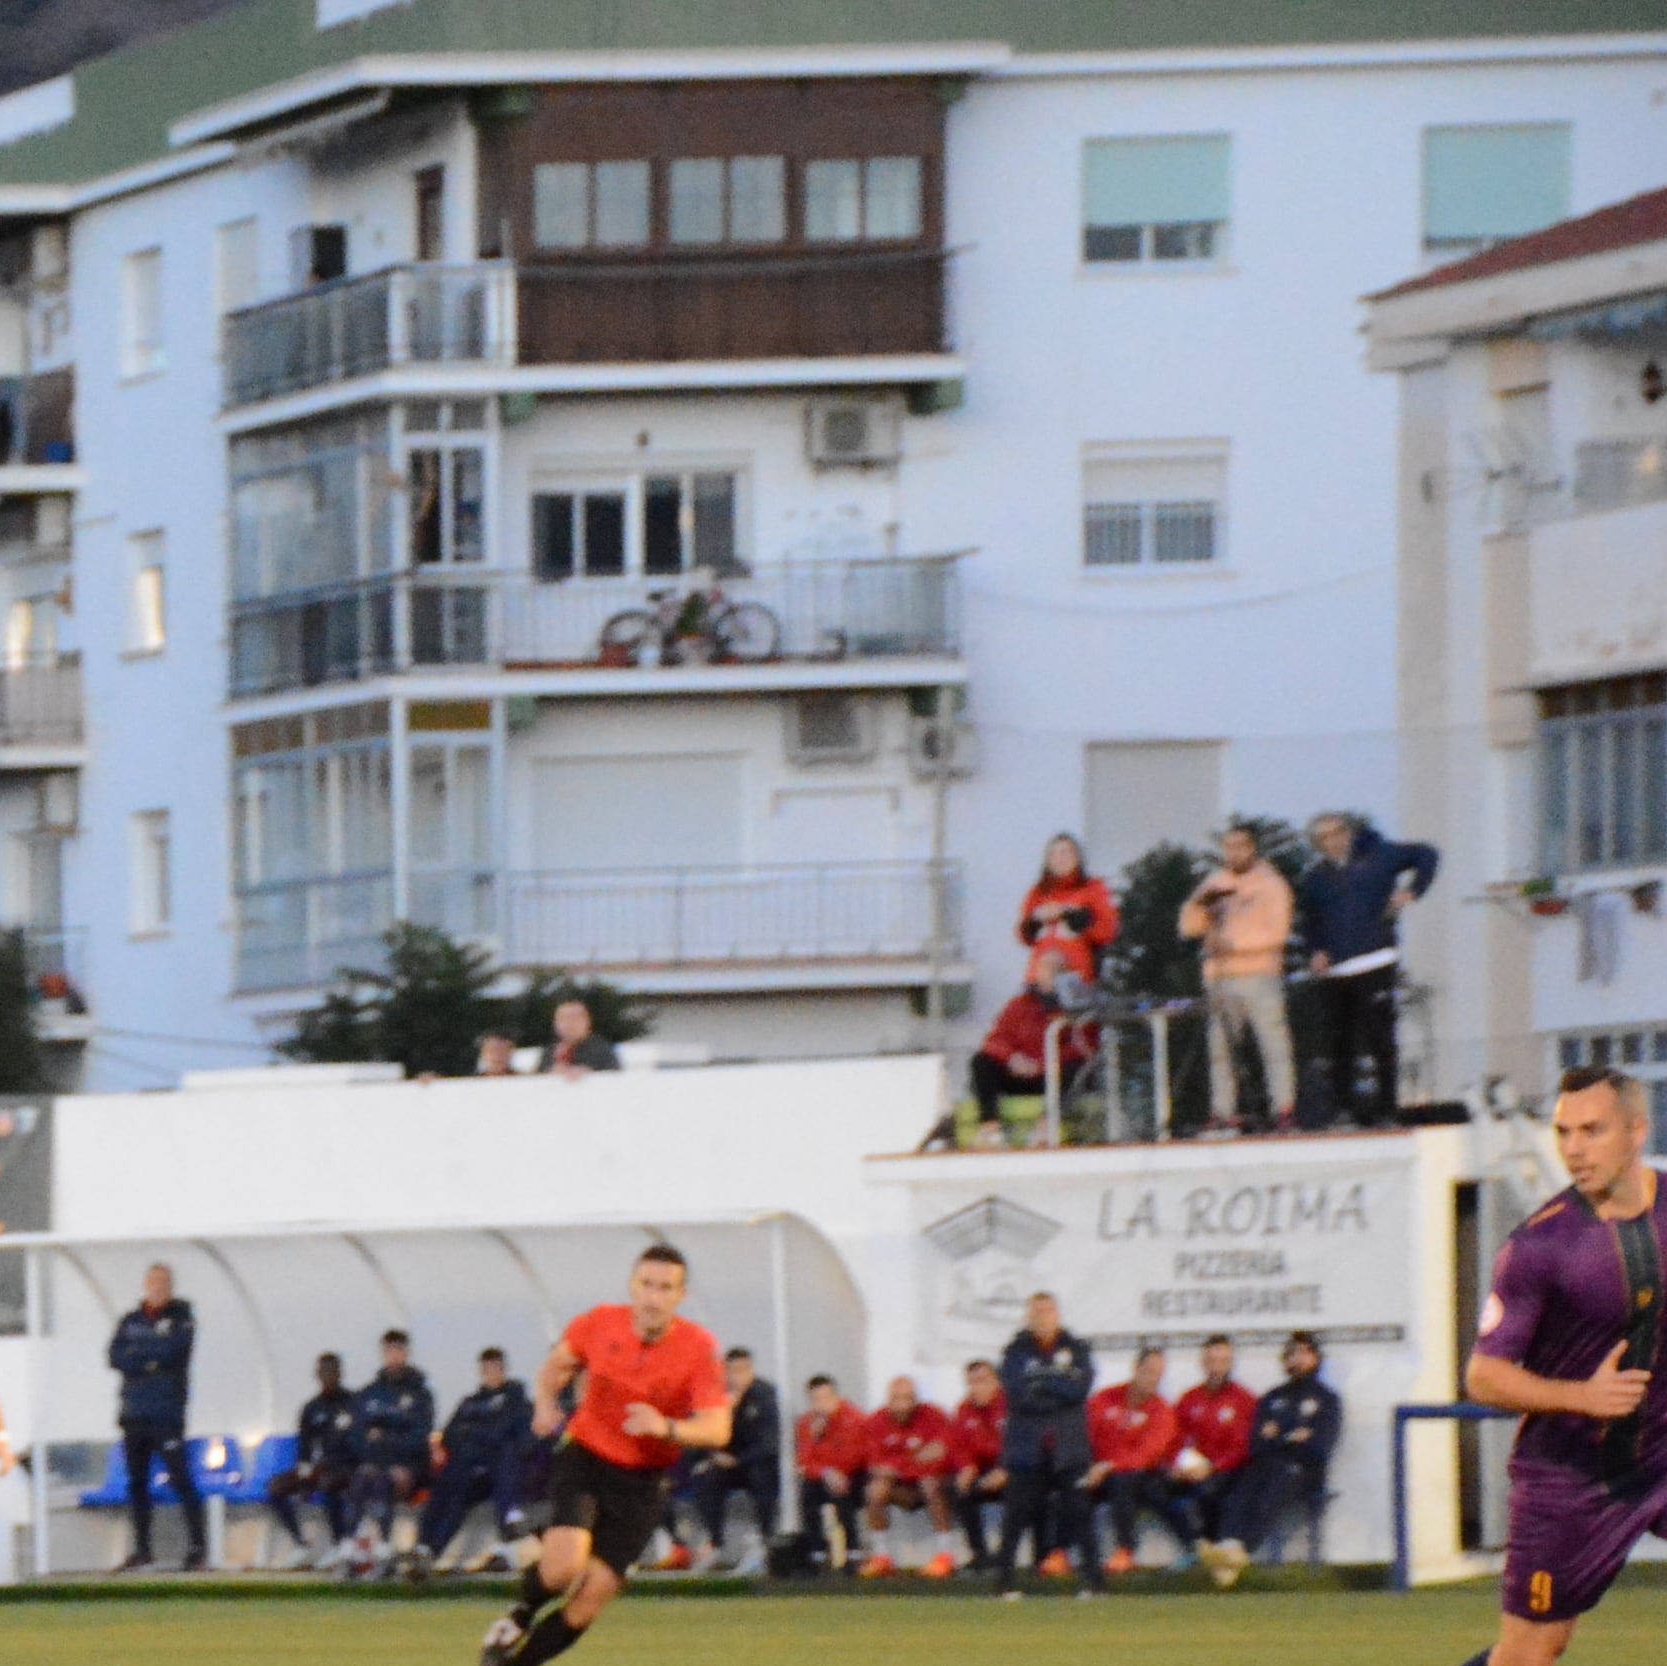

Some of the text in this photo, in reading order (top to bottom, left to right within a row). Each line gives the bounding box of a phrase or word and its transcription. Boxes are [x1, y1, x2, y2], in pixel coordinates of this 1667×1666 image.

[1097, 1182, 1369, 1241] LA ROIMA
[1173, 1250, 1288, 1279] PIZZERIA
[1140, 1284, 1323, 1319] RESTAURANTE
